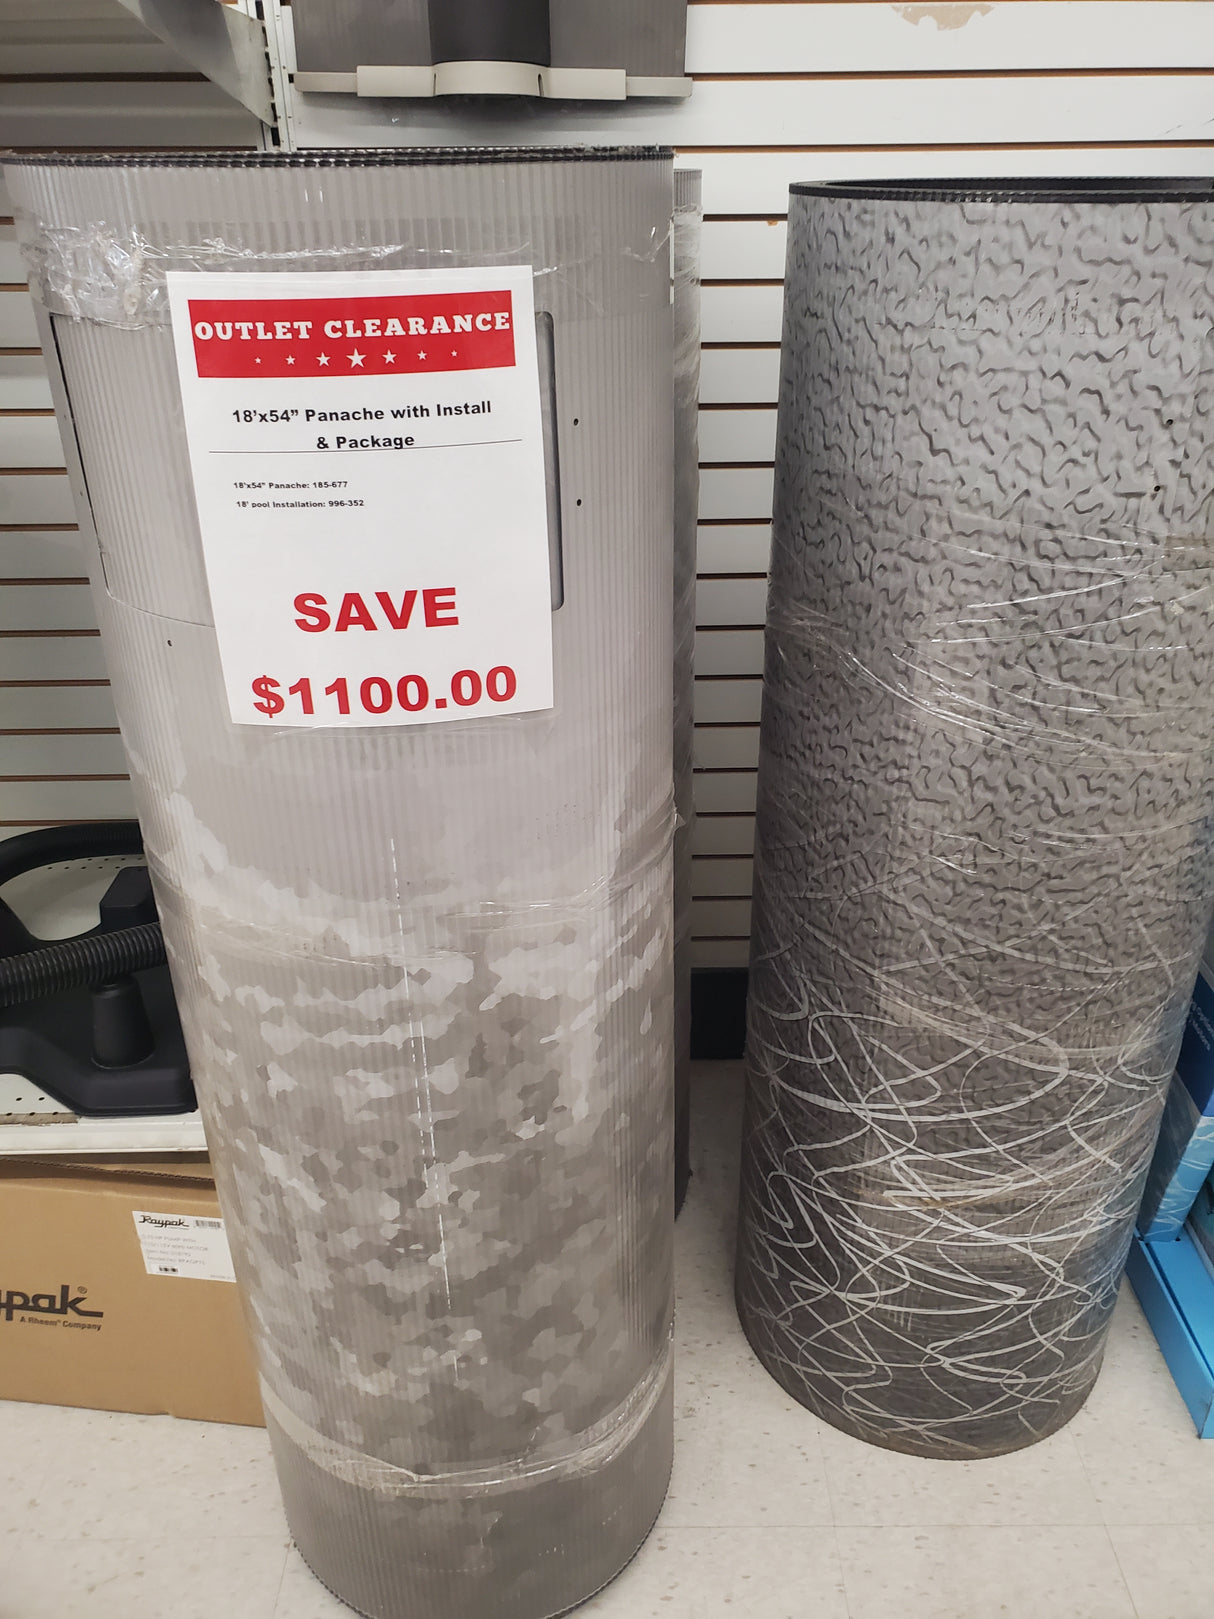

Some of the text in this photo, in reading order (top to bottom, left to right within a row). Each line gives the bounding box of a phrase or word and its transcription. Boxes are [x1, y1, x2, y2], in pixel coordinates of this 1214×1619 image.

[194, 311, 510, 341] OUTLET CLEARANCE
[232, 400, 491, 424] 18’x54” Panache with Install
[316, 434, 415, 450] & Package
[328, 499, 365, 507] 996-352
[293, 587, 459, 633] SAVE
[251, 665, 517, 718] $1100.00
[139, 1215, 190, 1229] Raypak
[62, 1321, 102, 1331] Company
